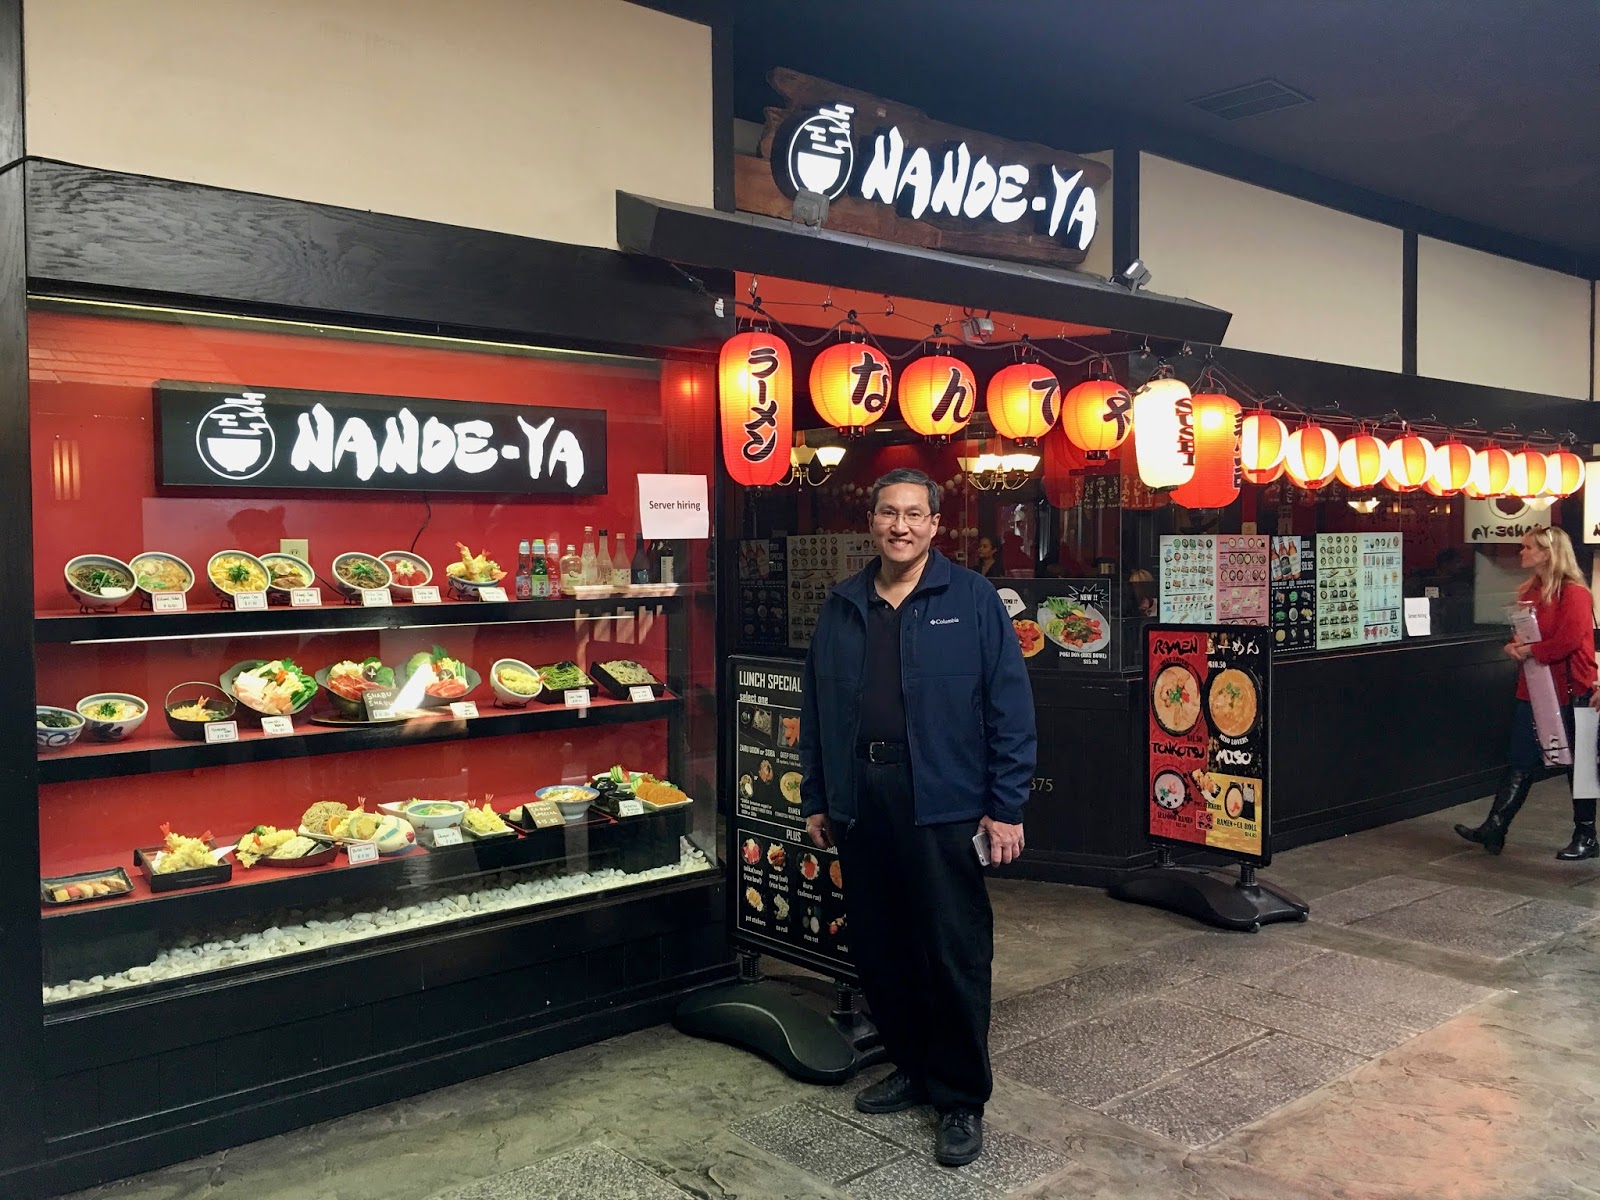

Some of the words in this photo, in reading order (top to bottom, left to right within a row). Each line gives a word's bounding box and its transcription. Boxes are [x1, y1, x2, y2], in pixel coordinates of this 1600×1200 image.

[861, 126, 1096, 250] NANDE-YA
[851, 351, 892, 413] な
[931, 367, 976, 424] ん
[742, 347, 779, 463] ラーメン
[1174, 397, 1195, 467] SUSHI
[291, 403, 584, 488] NANDE-YA
[649, 501, 675, 510] Server
[677, 500, 701, 512] hiring
[1153, 637, 1199, 655] RAMEN
[739, 671, 766, 688] LUNCH
[366, 692, 392, 700] SHABU
[740, 691, 756, 702] select
[758, 696, 768, 704] one
[1218, 733, 1230, 744] MISO
[1230, 736, 1249, 745] LOVERS
[765, 748, 776, 758] SOBA
[1216, 748, 1252, 766] MISO
[1216, 818, 1232, 826] RAMEN
[1244, 823, 1257, 832] ROLL
[786, 829, 801, 842] PLUS
[831, 891, 843, 900] curry
